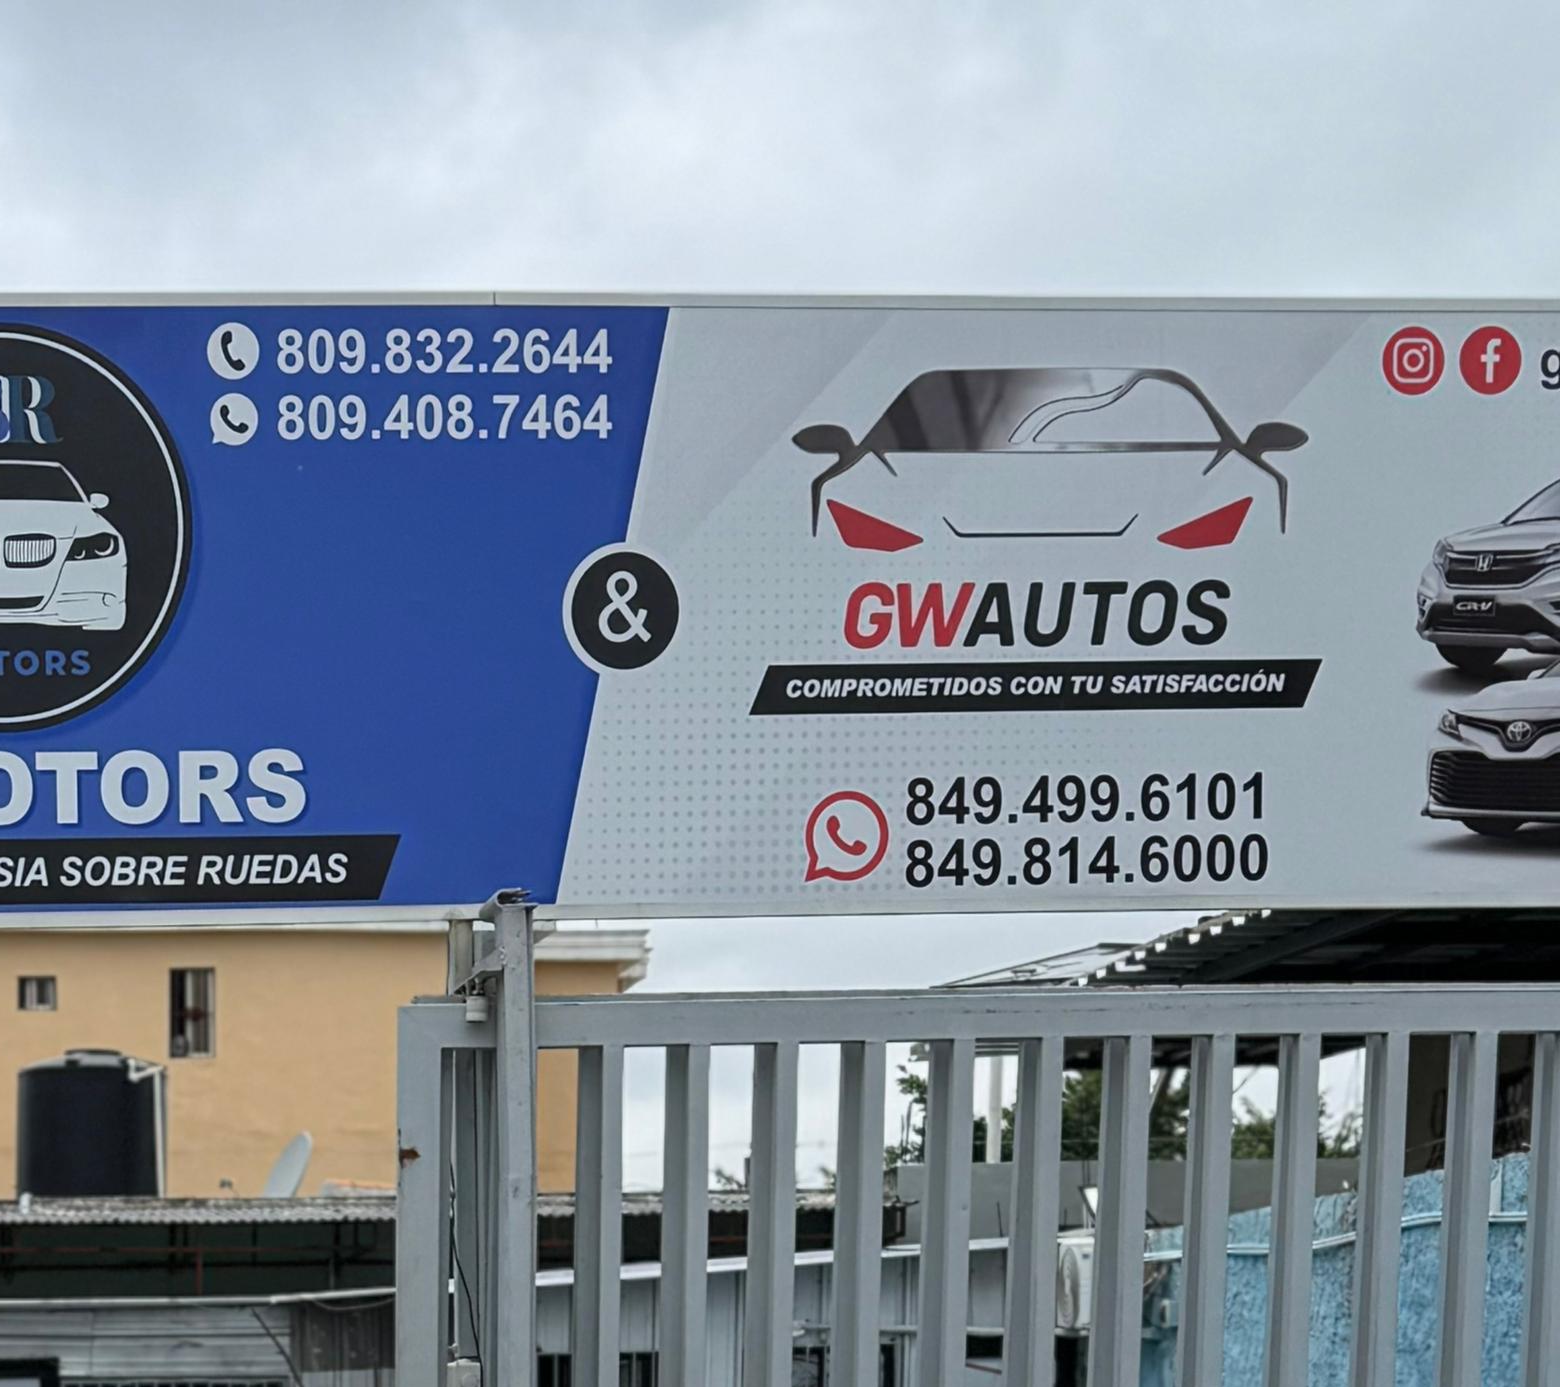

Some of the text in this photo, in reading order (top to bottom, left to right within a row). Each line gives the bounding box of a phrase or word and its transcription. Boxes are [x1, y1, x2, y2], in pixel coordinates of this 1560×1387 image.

[277, 327, 613, 374] 809.832.2644
[277, 393, 613, 441] 809.408.7464
[597, 572, 652, 644] &
[842, 578, 1231, 650] GWAUTOS
[786, 668, 1286, 699] COMPROMETIDOS CON TU SATISFACCIÓN
[906, 771, 1266, 825] 849.499.6101
[60, 853, 189, 886] SOBRE
[197, 851, 349, 885] RUEDAS
[904, 833, 1270, 889] 849.814.6000
